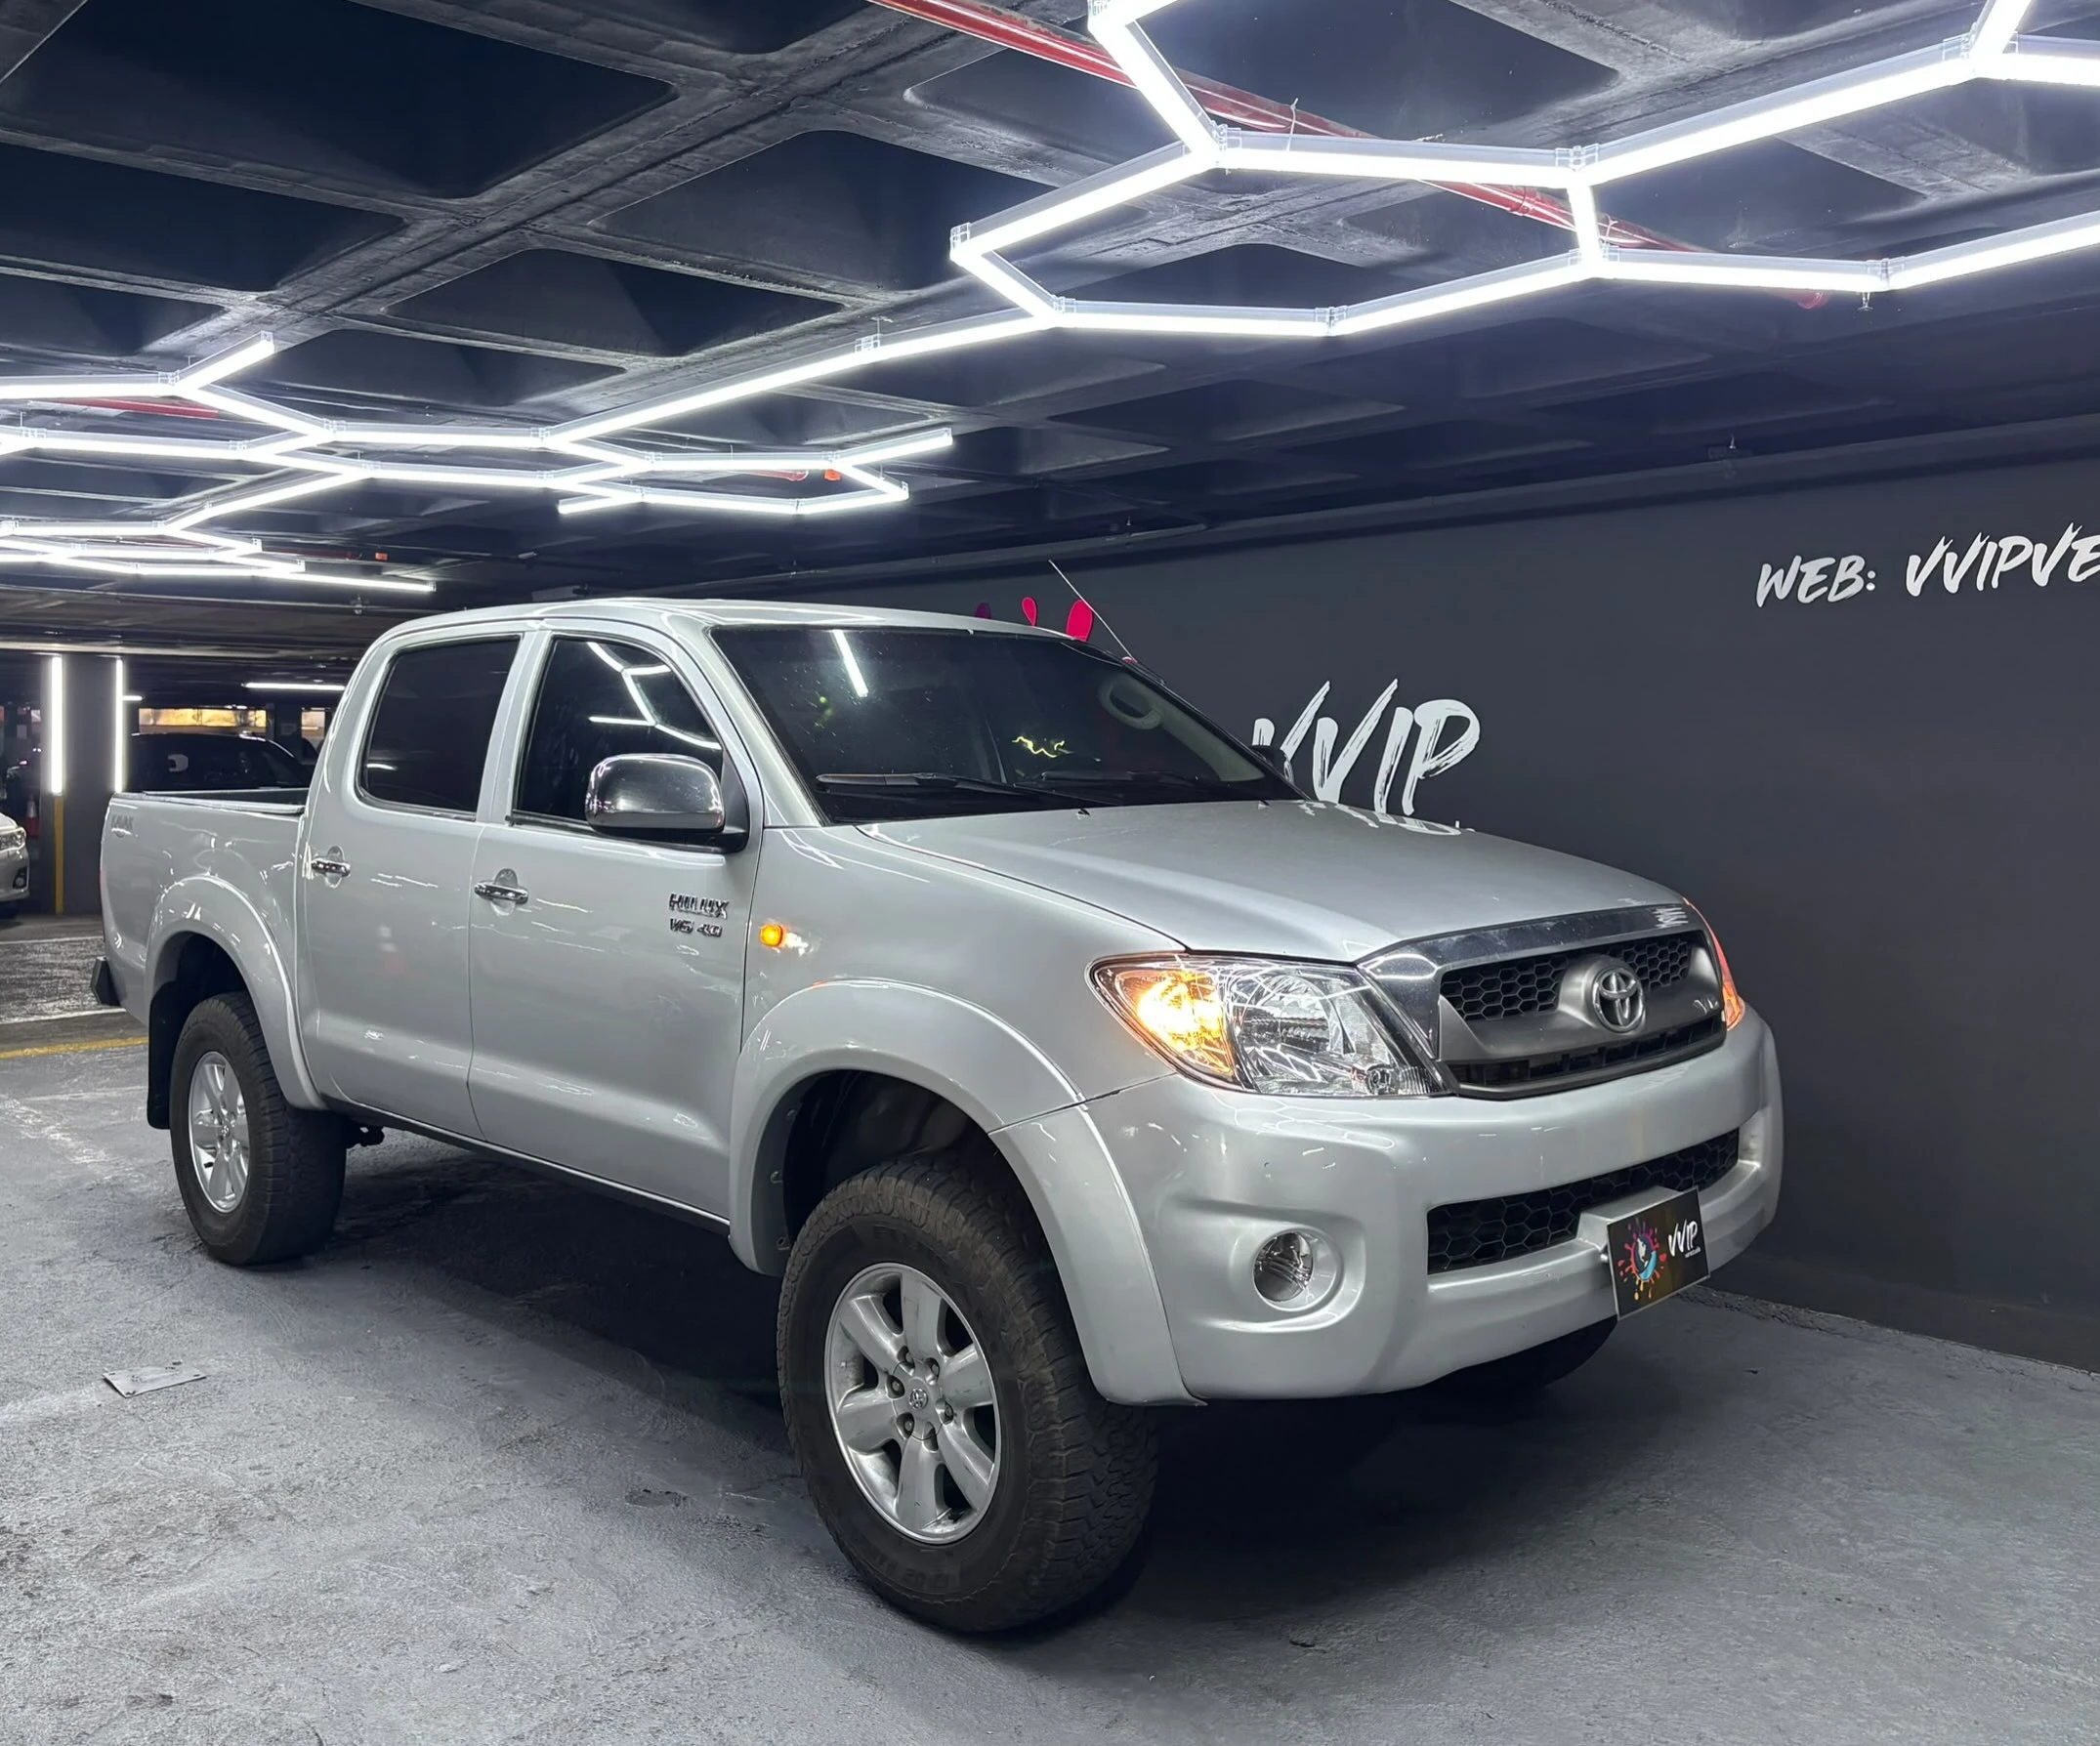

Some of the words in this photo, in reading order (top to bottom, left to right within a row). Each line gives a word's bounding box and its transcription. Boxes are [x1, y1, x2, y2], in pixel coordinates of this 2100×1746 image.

[1756, 555, 1876, 607] WEB:
[1906, 522, 2100, 597] VVIPVE
[1667, 1219, 1698, 1257] VVIP
